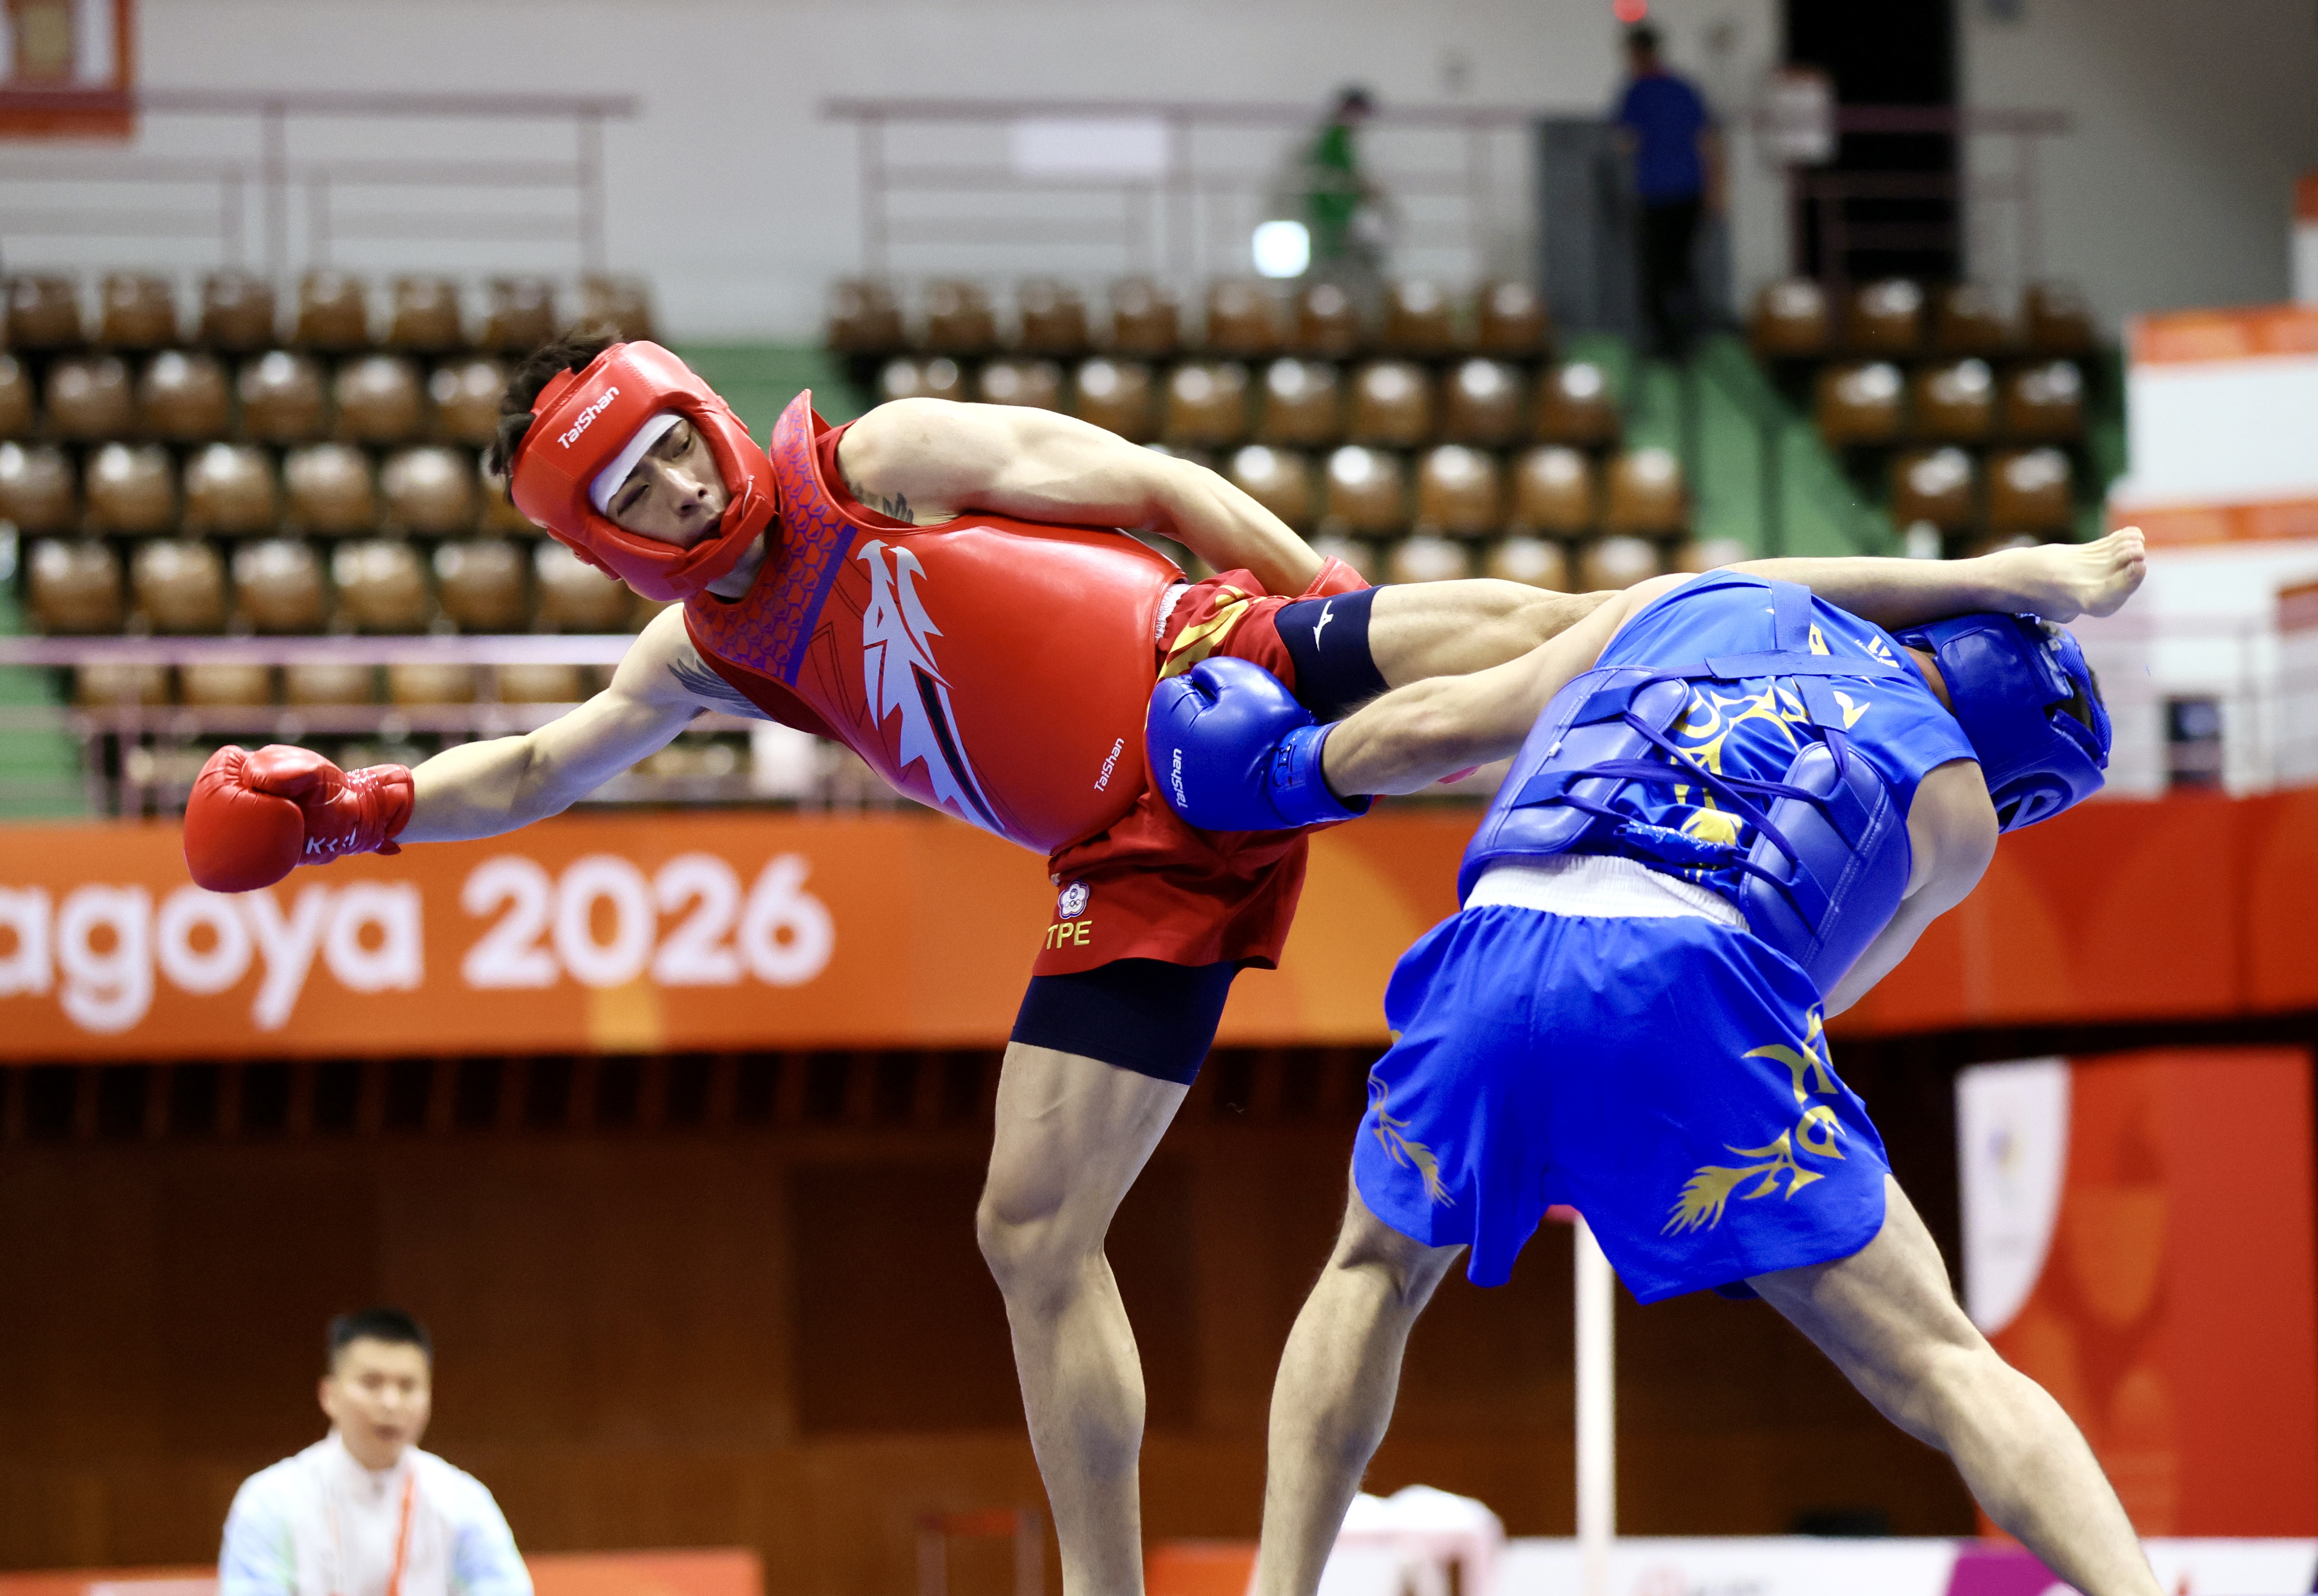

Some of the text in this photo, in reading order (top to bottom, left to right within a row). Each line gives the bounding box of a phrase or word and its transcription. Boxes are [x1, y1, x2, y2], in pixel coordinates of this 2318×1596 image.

[557, 386, 620, 449] TaiShan
[1093, 737, 1125, 792] TaiShan
[1171, 748, 1189, 808] TaiShan
[461, 854, 834, 988] 2026
[1046, 920, 1092, 950] TPE
